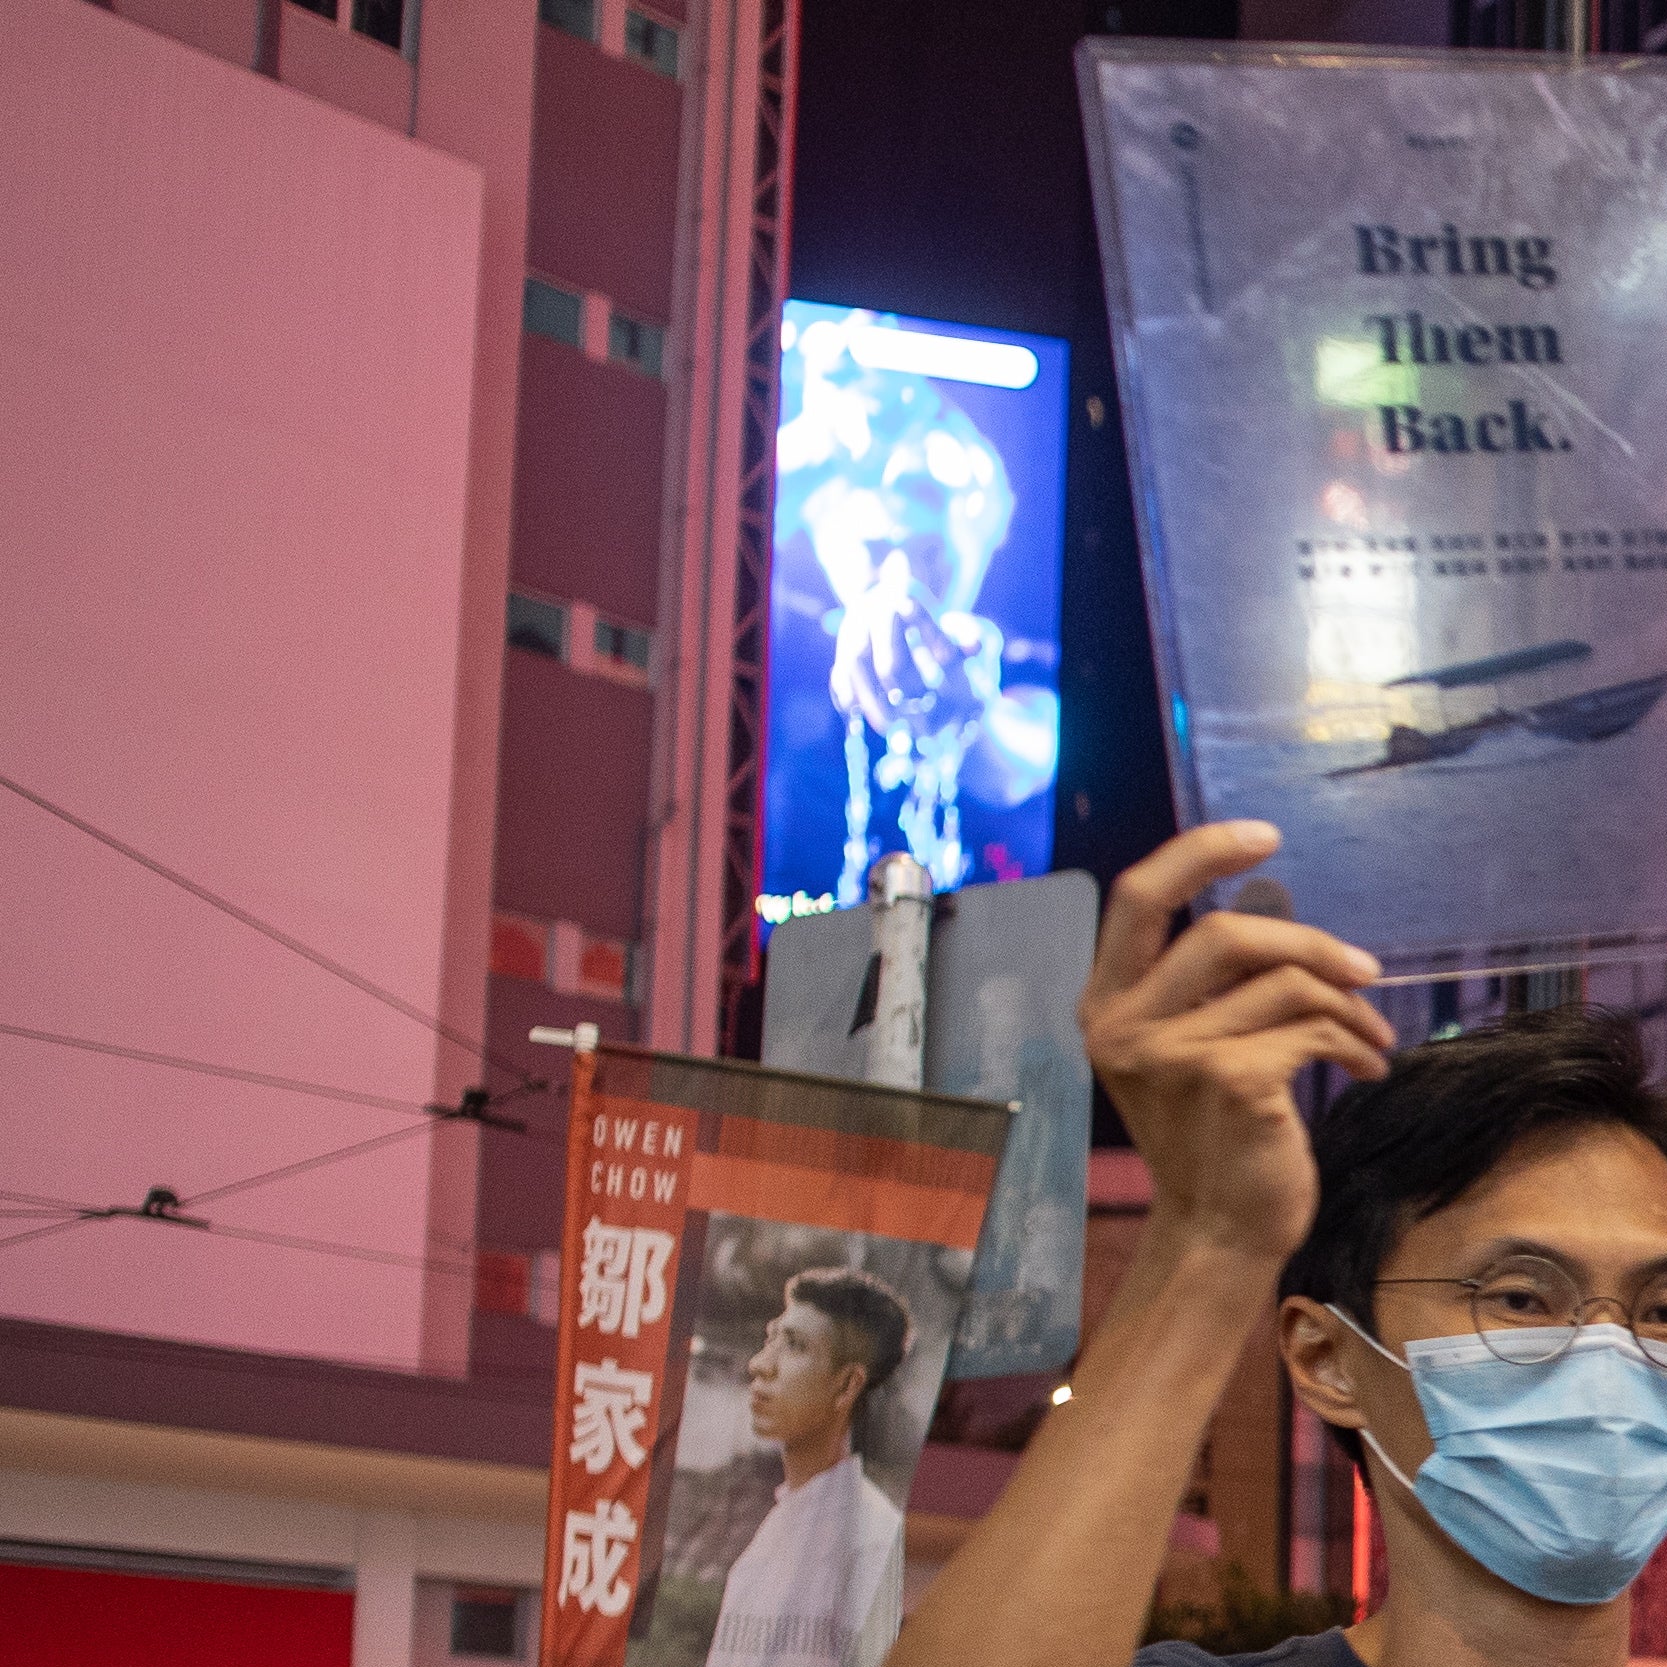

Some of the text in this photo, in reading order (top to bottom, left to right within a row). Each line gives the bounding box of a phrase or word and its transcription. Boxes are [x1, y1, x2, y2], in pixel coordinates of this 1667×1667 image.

[1353, 224, 1557, 287] Bring
[1366, 311, 1561, 366] Them
[1379, 399, 1571, 456] Back.
[593, 1114, 684, 1158] OWEN
[591, 1161, 678, 1204] CHOW
[559, 1216, 675, 1618] 鄒家成
